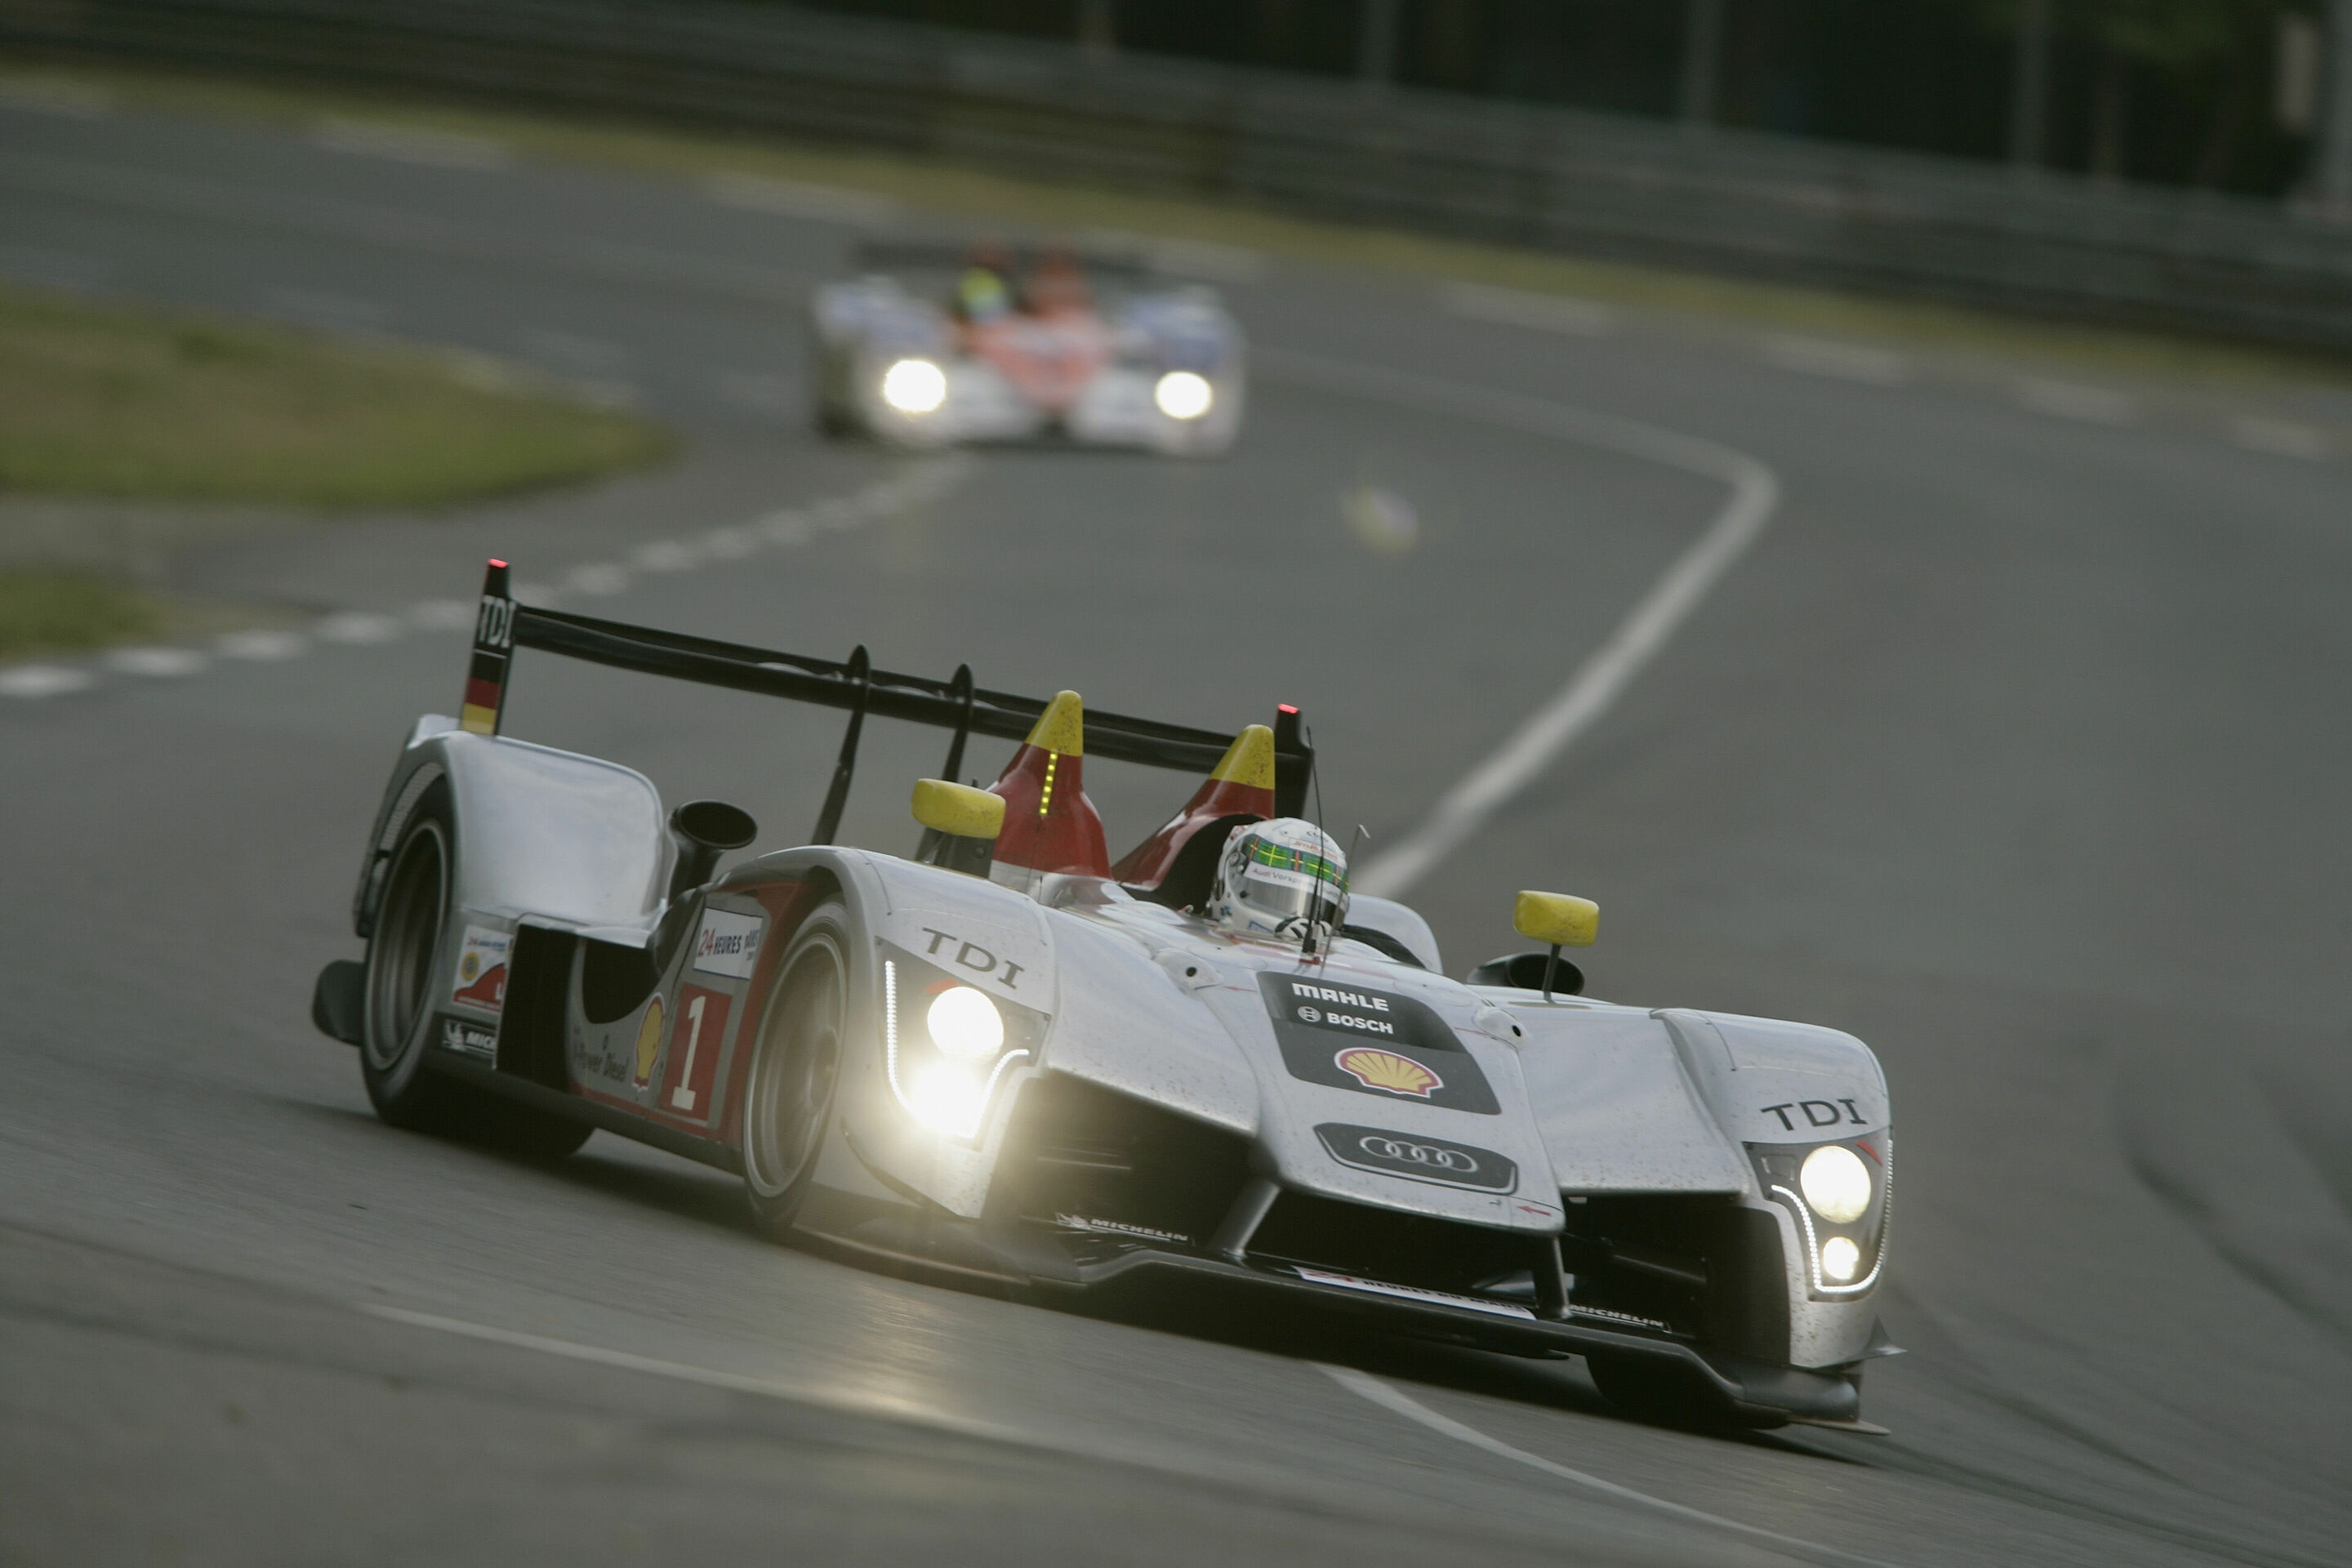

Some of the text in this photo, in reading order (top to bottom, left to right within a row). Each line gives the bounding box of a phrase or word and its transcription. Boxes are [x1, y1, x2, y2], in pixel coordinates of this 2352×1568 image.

[479, 595, 517, 648] TDI
[698, 929, 716, 956] 24
[713, 935, 742, 955] HEURES
[920, 927, 1025, 990] TDI
[1291, 982, 1389, 1012] MAHLE
[1326, 1012, 1393, 1035] BOSCH
[671, 996, 706, 1111] 1
[1760, 1098, 1867, 1131] TDI
[1090, 1218, 1188, 1241] MICHELIN
[1568, 1304, 1664, 1328] MICHELIN
